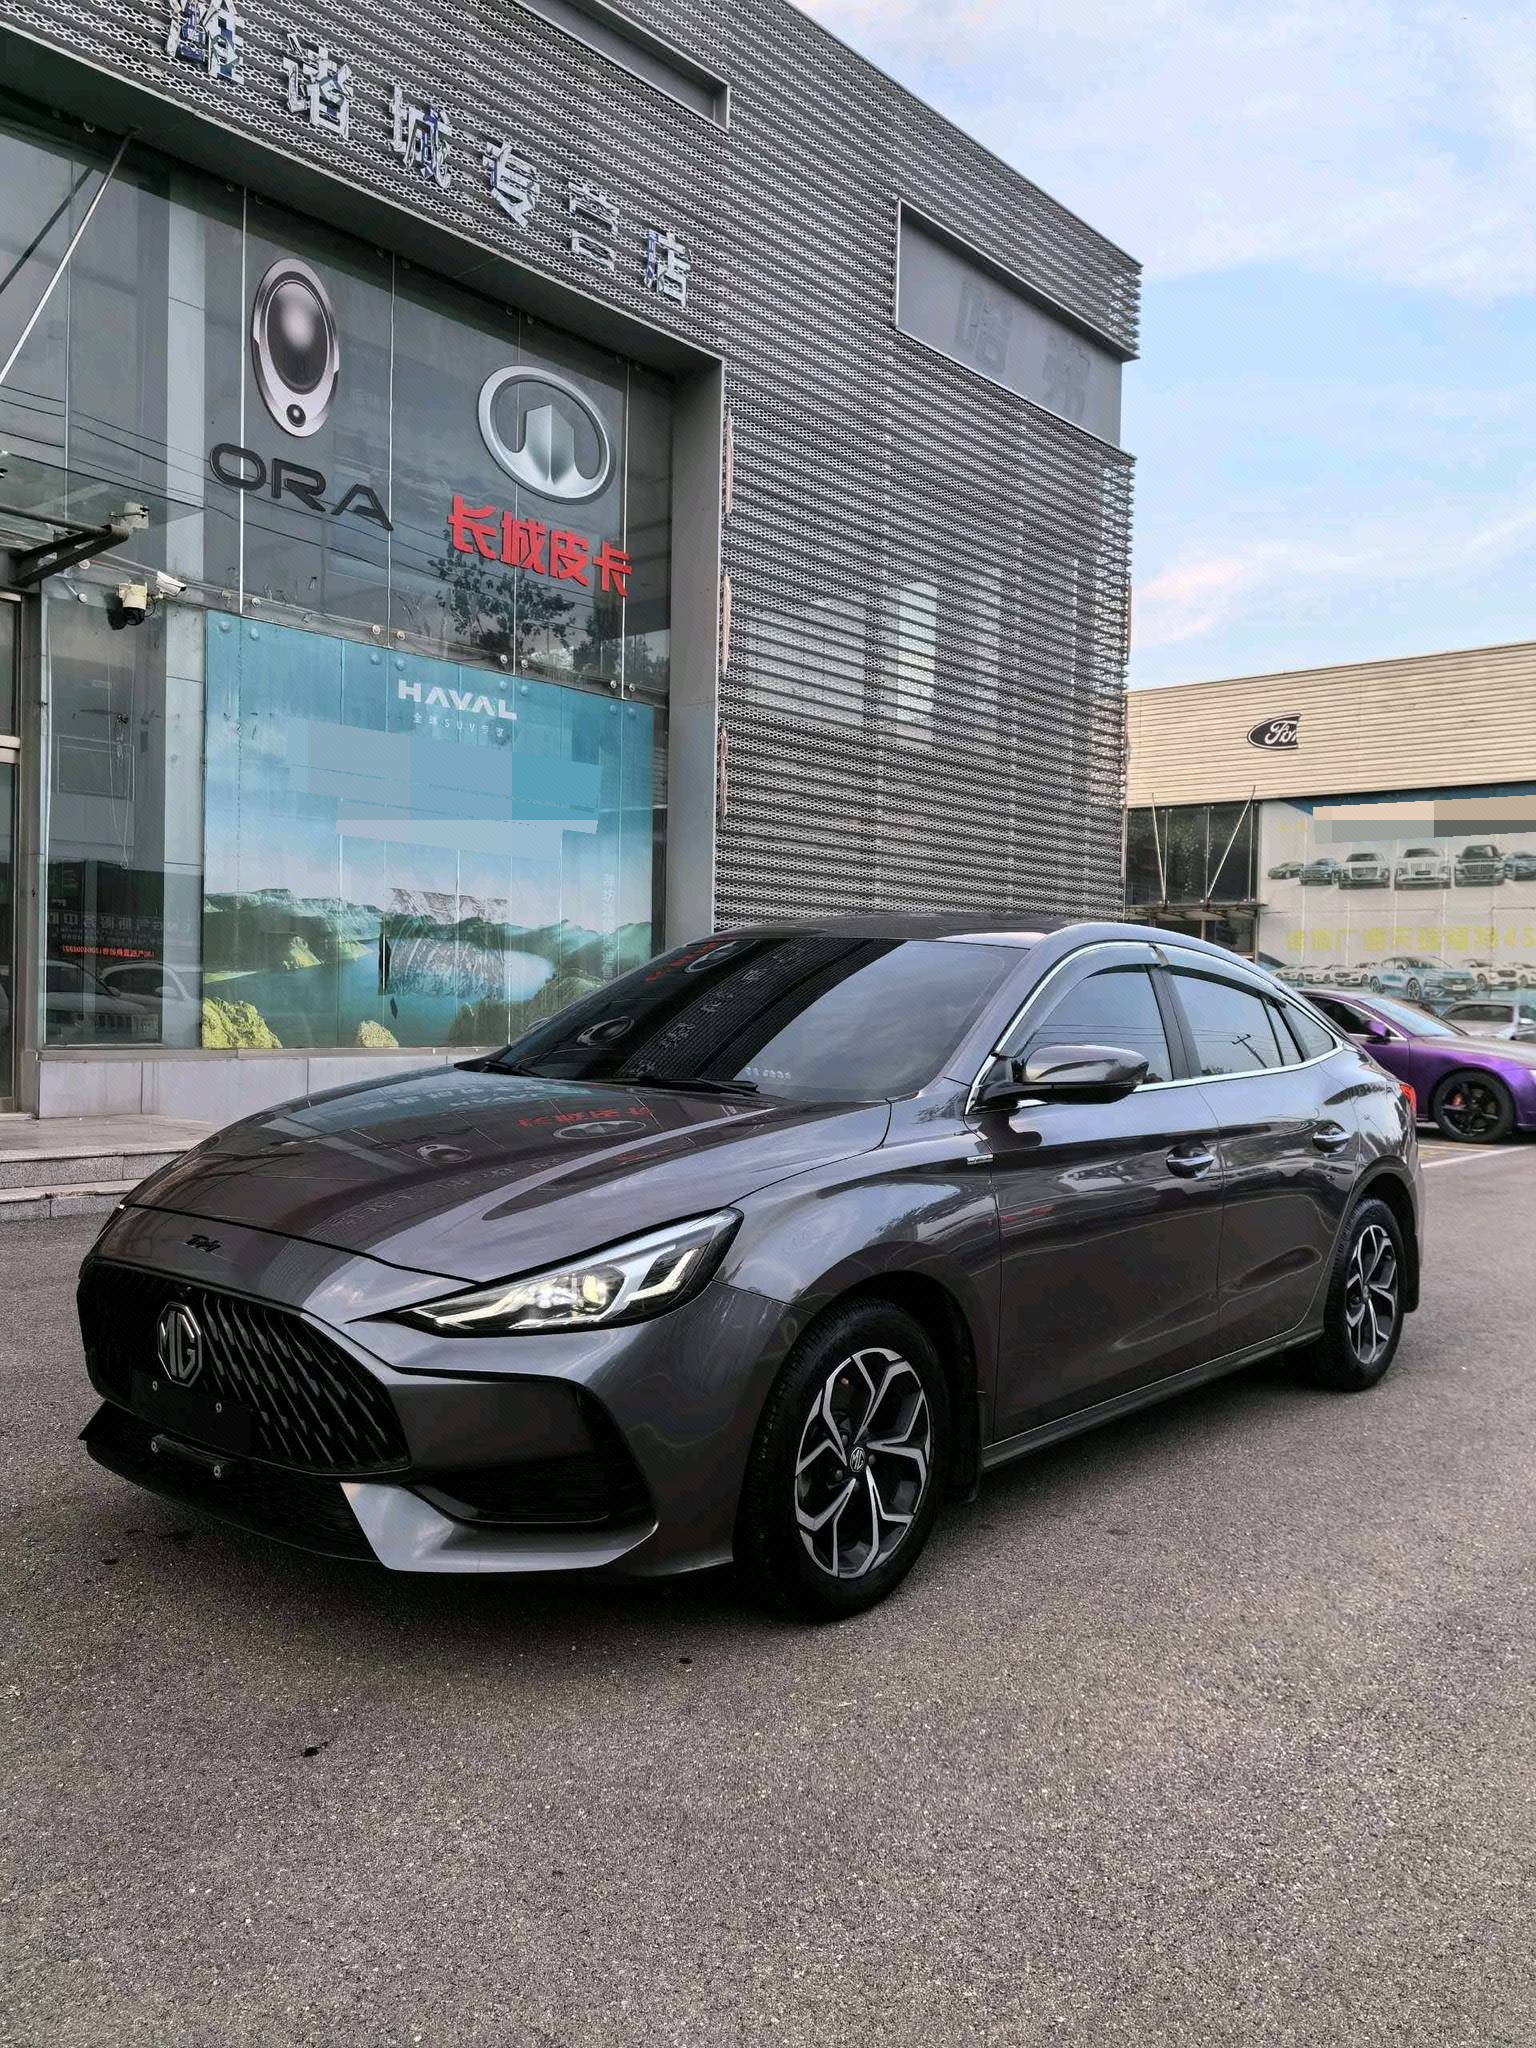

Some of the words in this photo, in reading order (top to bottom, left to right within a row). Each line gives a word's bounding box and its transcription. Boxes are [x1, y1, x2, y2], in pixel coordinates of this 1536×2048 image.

[209, 443, 394, 532] ORA
[447, 495, 633, 598] 长城皮卡
[398, 679, 518, 720] HAVAL
[158, 1309, 198, 1381] MG
